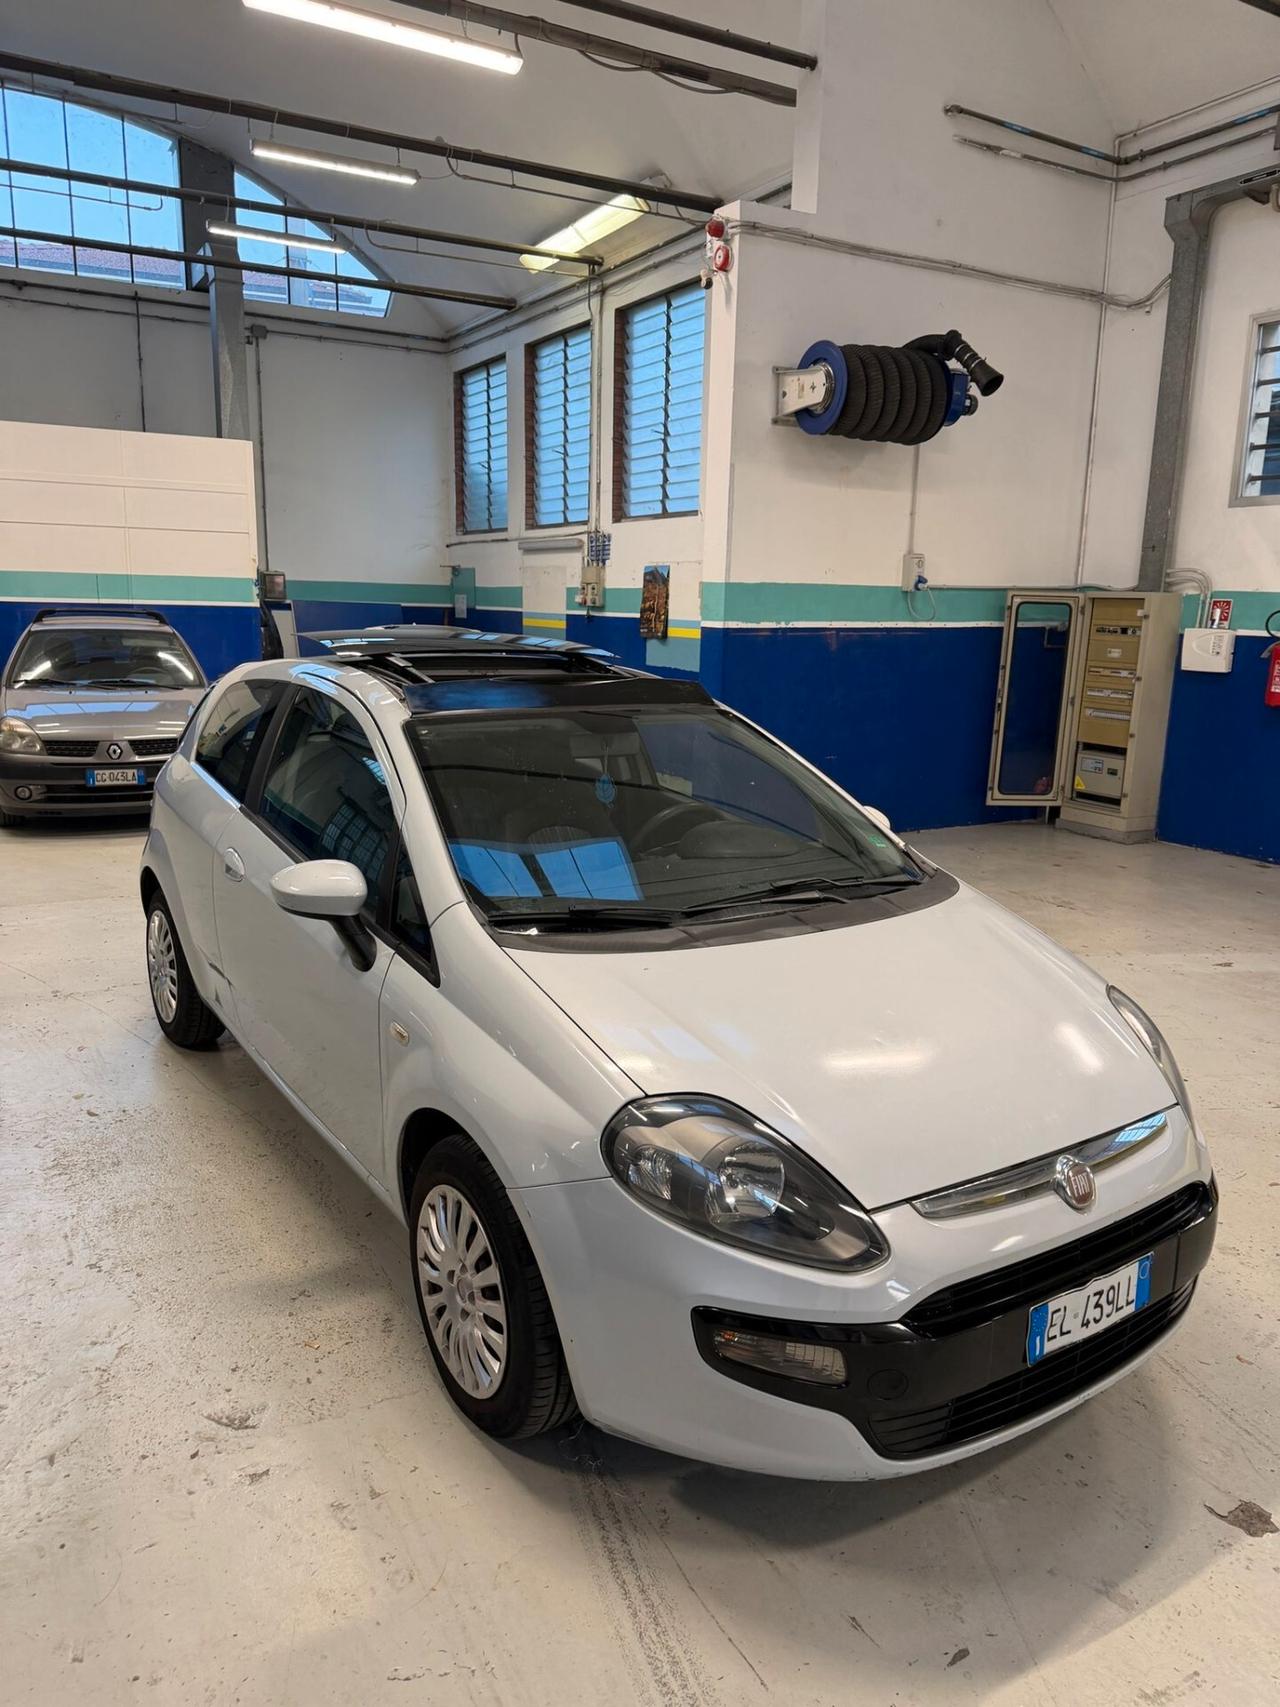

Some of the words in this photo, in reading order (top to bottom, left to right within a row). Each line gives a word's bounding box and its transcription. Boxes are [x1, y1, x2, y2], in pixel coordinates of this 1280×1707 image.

[1071, 1173, 1090, 1198] FIAT
[1046, 1302, 1072, 1342] EL
[1080, 1275, 1135, 1329] 439LL
